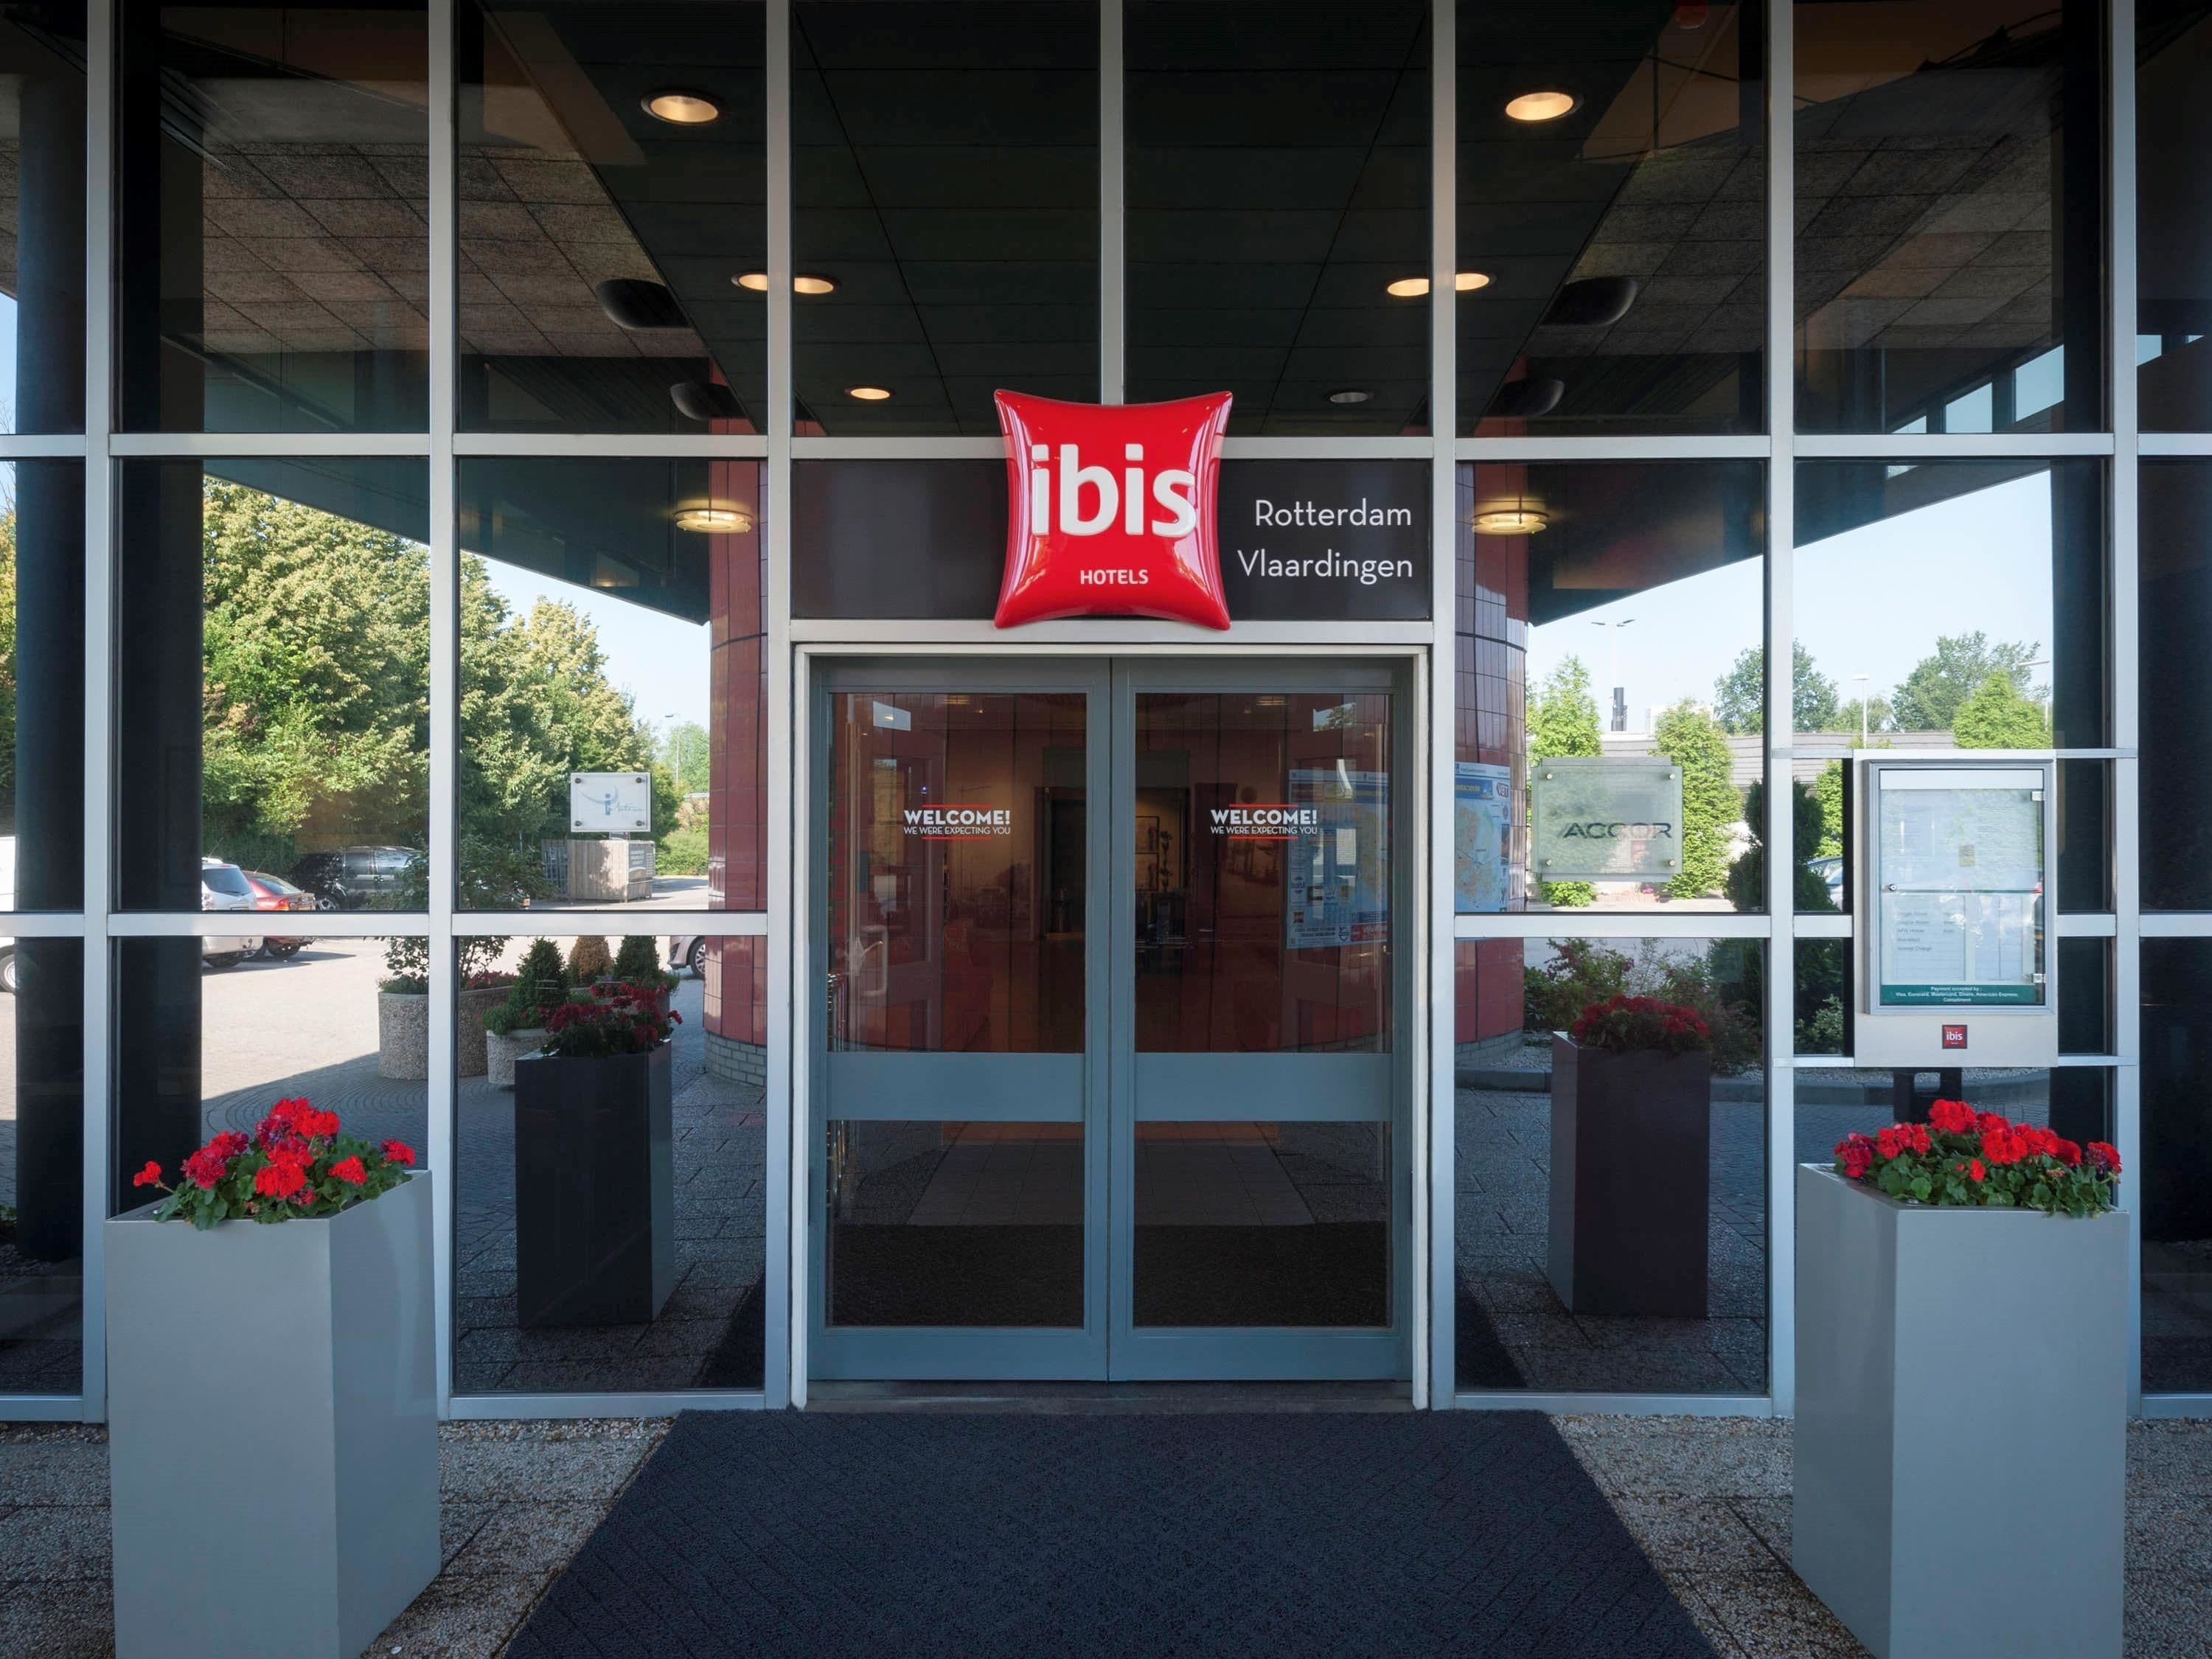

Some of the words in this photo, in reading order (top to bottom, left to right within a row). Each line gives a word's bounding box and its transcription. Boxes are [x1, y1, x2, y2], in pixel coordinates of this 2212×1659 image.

[1031, 443, 1197, 538] ibis
[1255, 498, 1412, 526] Rotterdam
[1237, 549, 1413, 585] Vlaardingen
[1080, 568, 1149, 585] HOTELS
[903, 810, 1011, 825] WELCOME!
[1210, 810, 1317, 825] WELCOME!
[903, 827, 917, 835] WE
[919, 827, 942, 835] WERE
[945, 827, 990, 835] EXPECTING
[992, 827, 1010, 835] YOU
[1211, 827, 1224, 835] WE
[1226, 827, 1249, 835] WERE
[1251, 827, 1297, 835] EXPECTING
[1299, 827, 1317, 835] YOU
[1946, 1031, 1964, 1040] ibis
